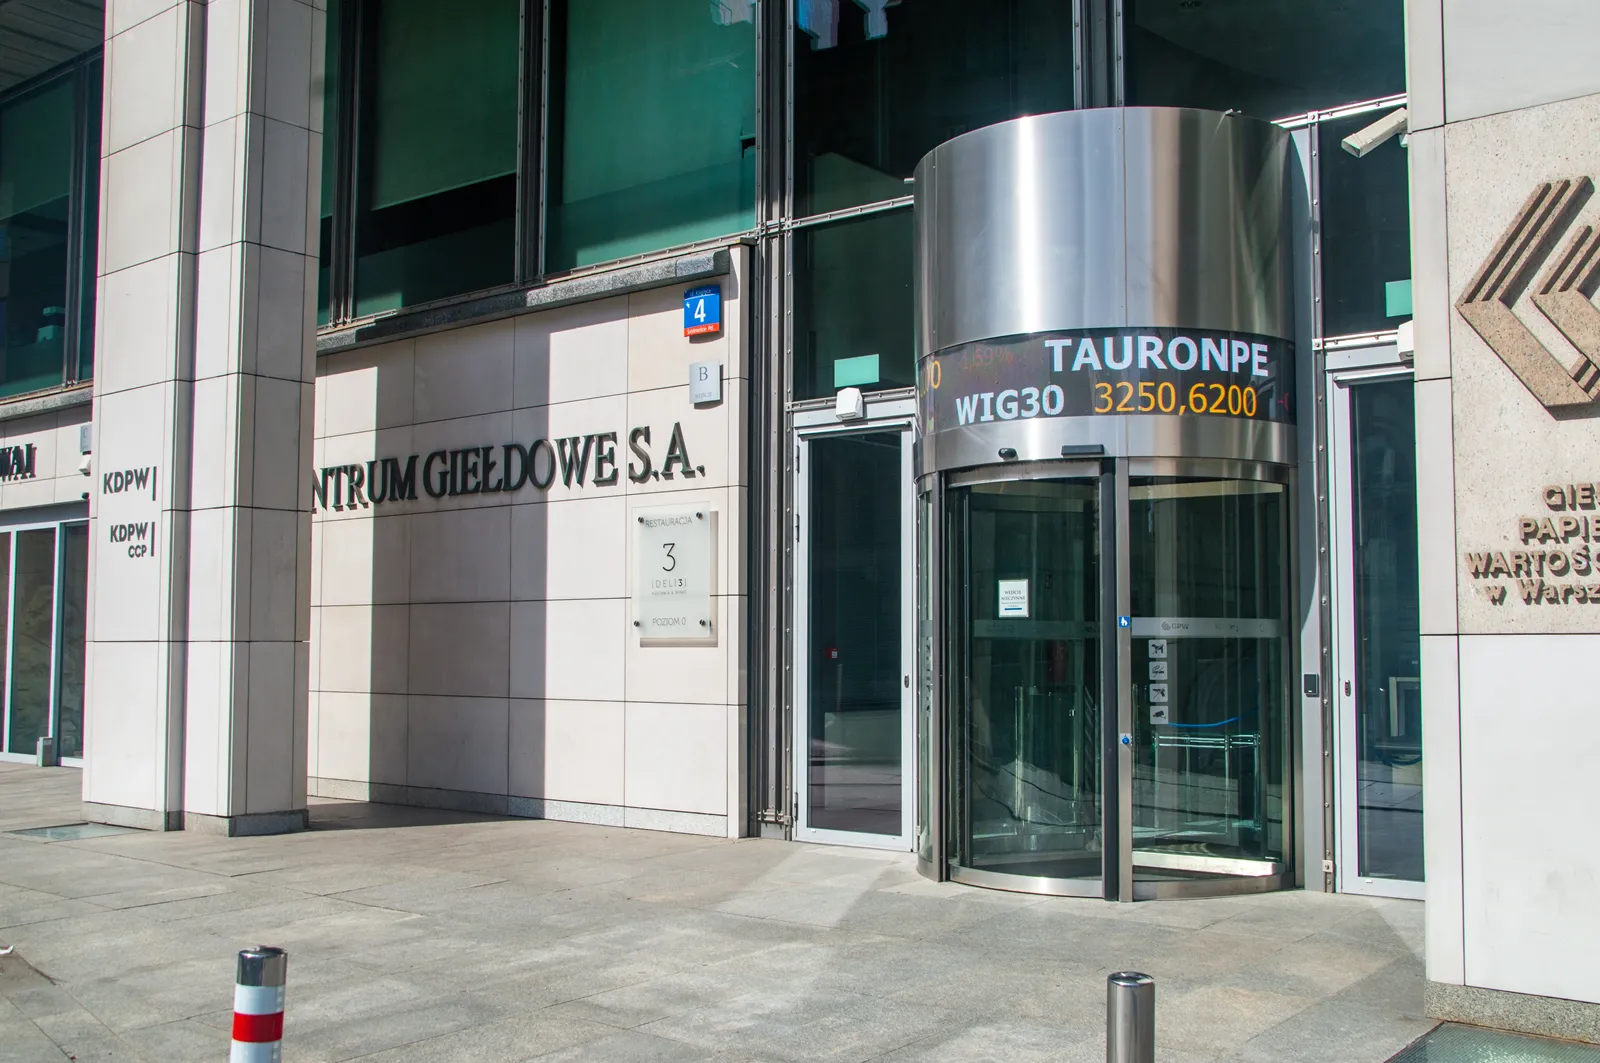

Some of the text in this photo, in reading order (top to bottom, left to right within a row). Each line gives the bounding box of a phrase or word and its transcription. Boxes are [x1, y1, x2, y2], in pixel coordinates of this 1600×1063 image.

[694, 299, 706, 323] 4
[1044, 336, 1269, 377] TAURONPE
[698, 366, 709, 382] B
[955, 386, 1065, 426] WIG30
[1095, 381, 1257, 417] 3250,6200
[422, 431, 620, 499] GIEŁDOWE
[628, 422, 706, 485] S.A.
[103, 467, 150, 495] KDPW
[1543, 483, 1600, 512] GIE
[110, 521, 148, 543] KDPW
[645, 516, 693, 528] RESTAURACJA
[128, 544, 147, 559] CCP
[662, 542, 676, 572] 3
[1485, 585, 1507, 606] w
[652, 617, 679, 627] POZIOM
[1171, 622, 1190, 631] GPW
